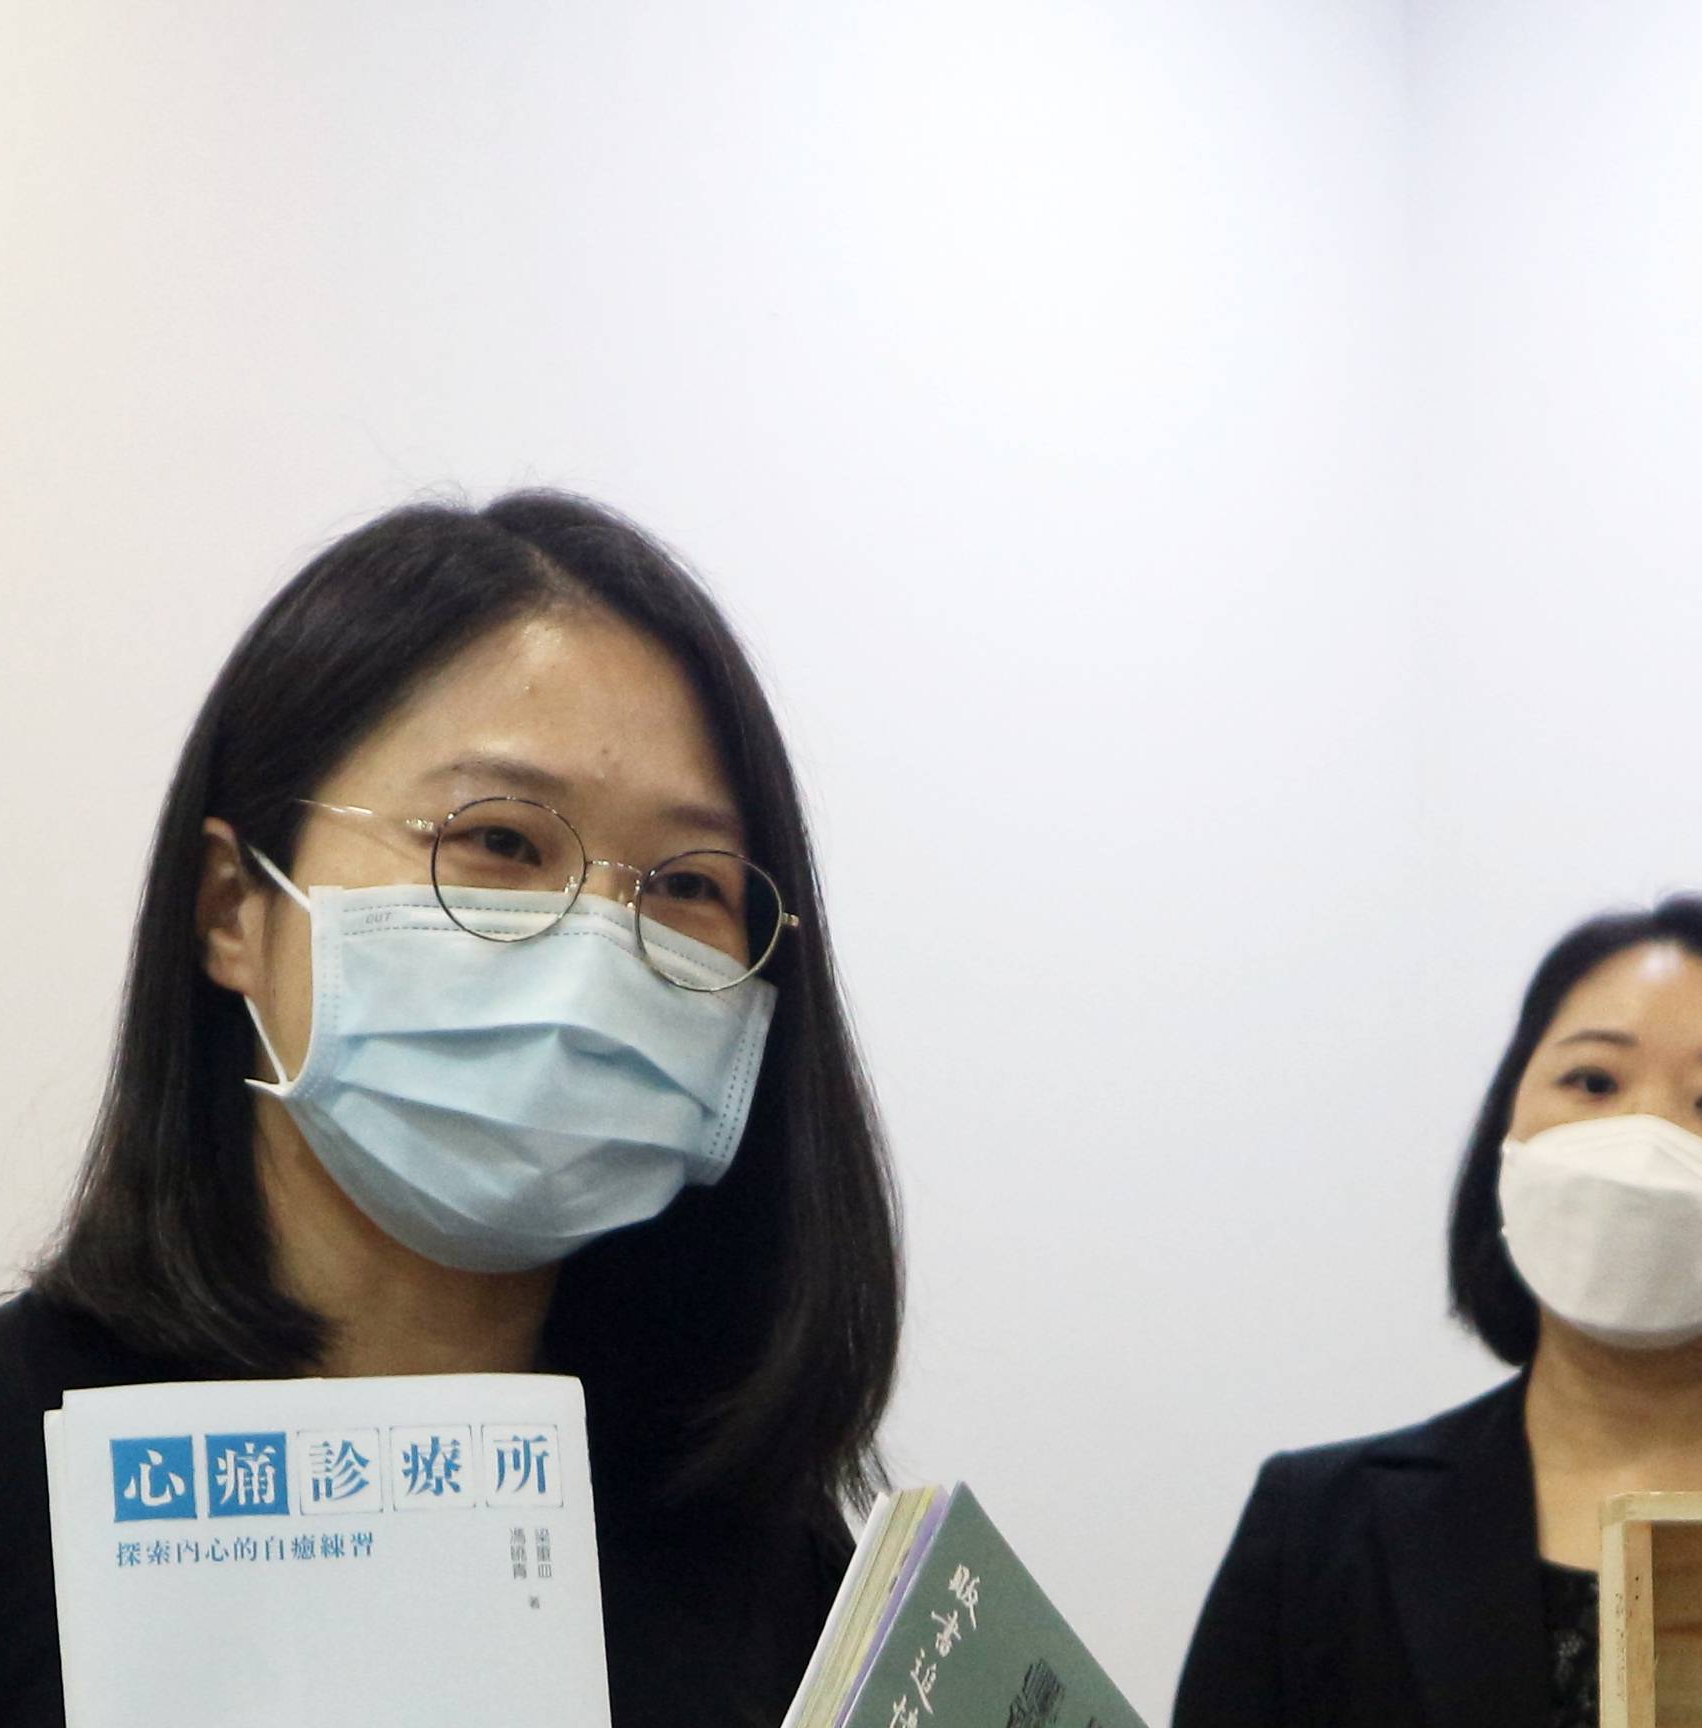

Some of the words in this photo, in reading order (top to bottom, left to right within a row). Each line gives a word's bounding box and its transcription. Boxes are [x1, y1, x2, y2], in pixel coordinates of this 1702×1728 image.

[123, 1434, 551, 1505] 心痛診療所
[116, 1532, 375, 1567] 探索內心的自癒練習
